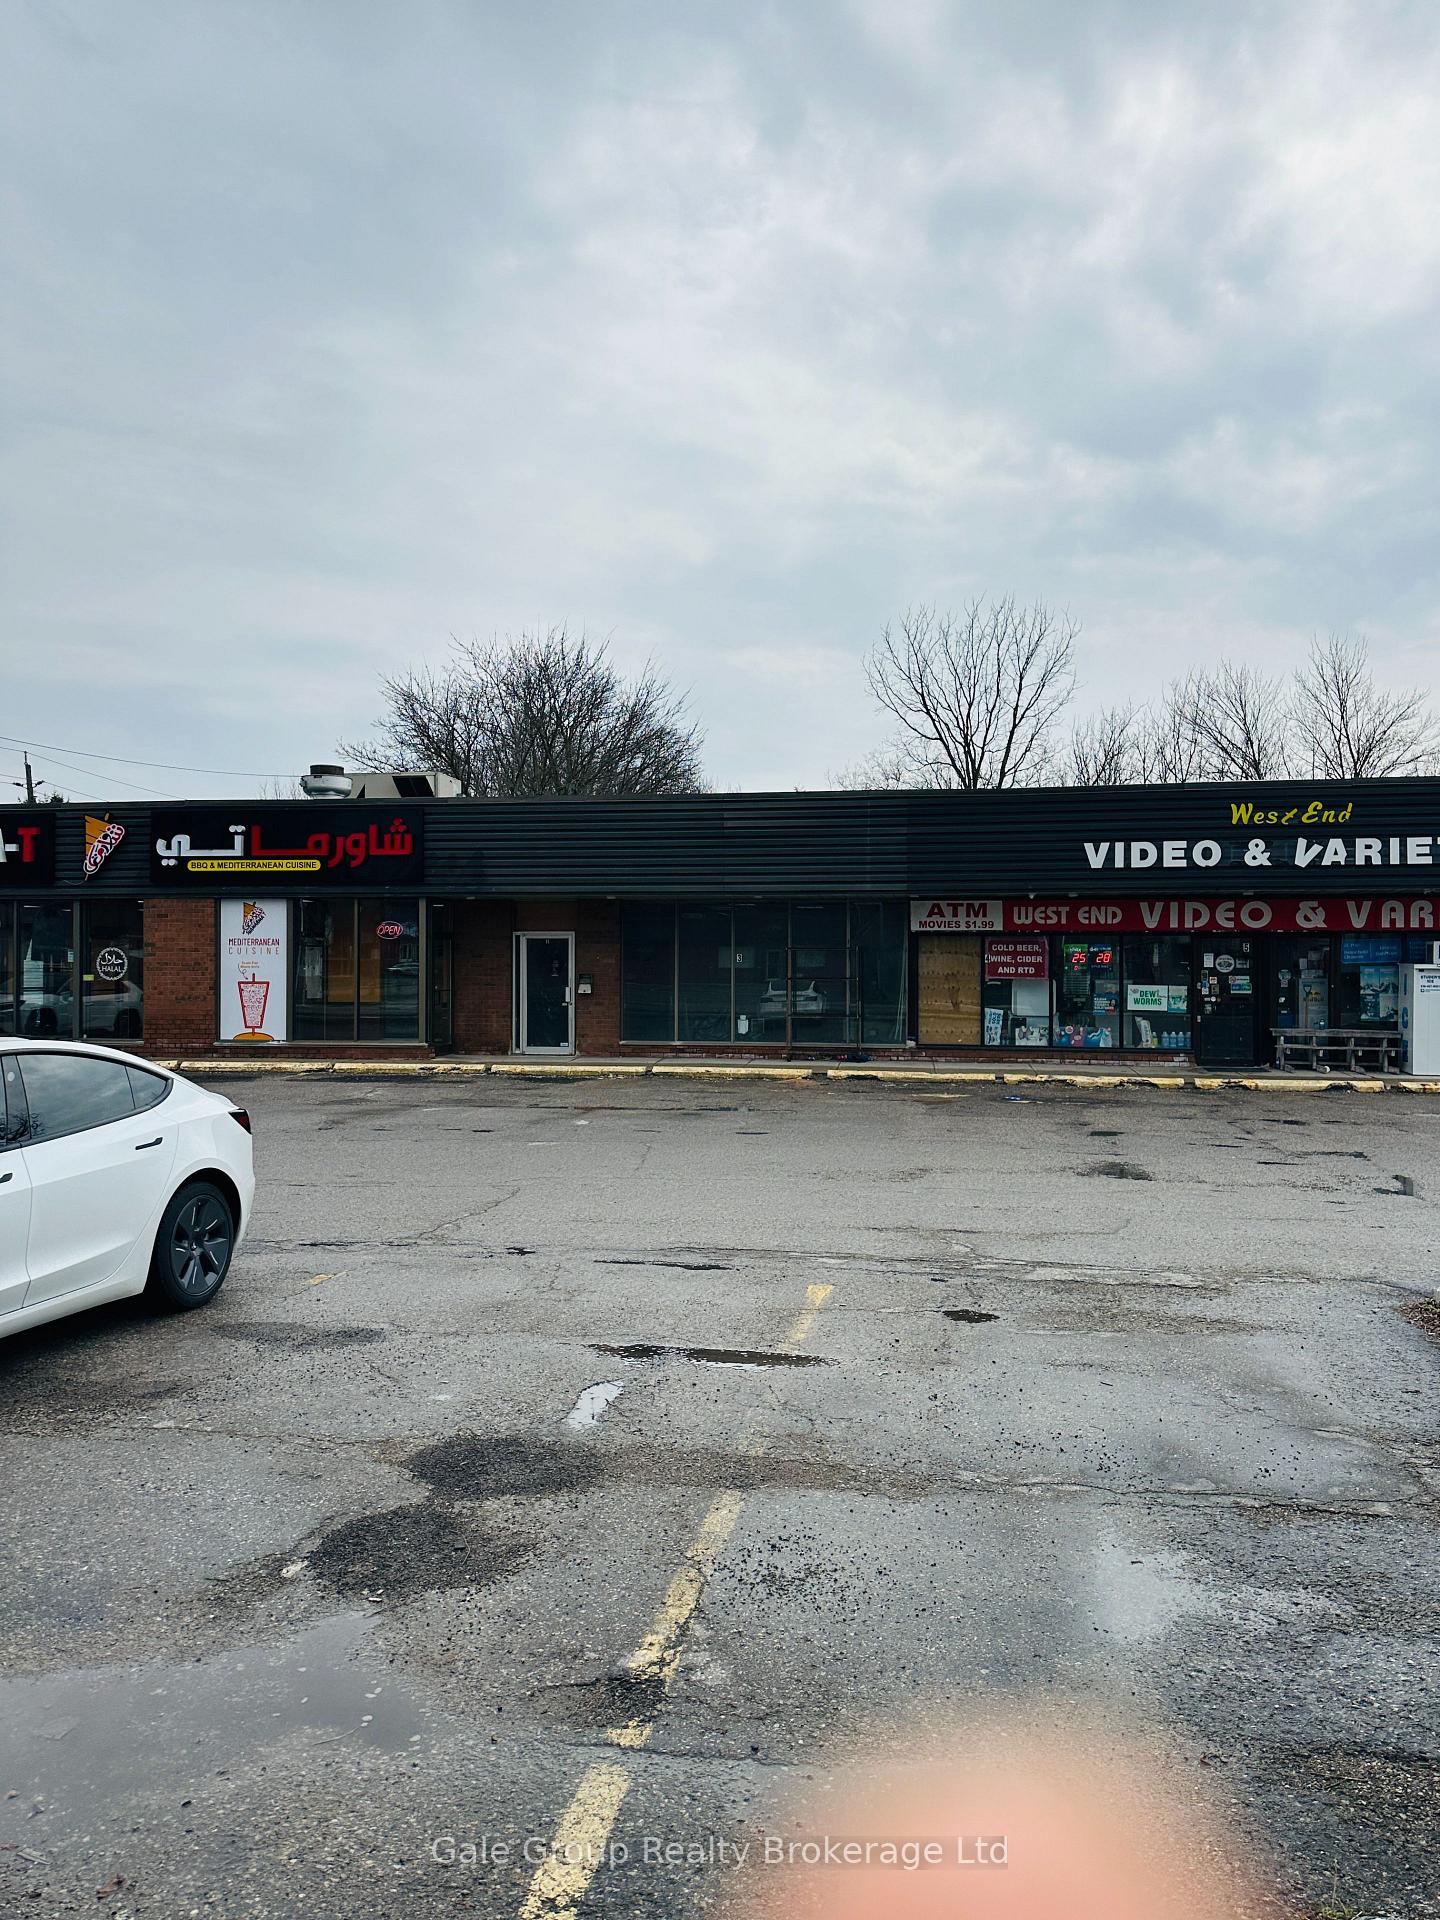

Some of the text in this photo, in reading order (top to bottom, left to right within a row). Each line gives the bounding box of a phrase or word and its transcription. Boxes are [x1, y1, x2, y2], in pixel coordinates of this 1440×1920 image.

[1230, 801, 1353, 825] West End
[0, 826, 41, 863] -T
[1083, 836, 1440, 869] VIDEO & VARIE
[190, 861, 317, 870] BBQ & MEDITERRANEAN CUISINE
[927, 903, 988, 918] ATM
[1013, 900, 1440, 929] WEST END VIDEO & VAR
[919, 920, 995, 929] MOVIES $1.99
[378, 925, 401, 936] OPEN
[229, 938, 280, 946] MEDITERRANEAN
[229, 947, 280, 955] CUISINE
[992, 944, 1042, 953] COLD BEER,
[1243, 943, 1250, 952] 5
[736, 953, 743, 963] 3
[990, 954, 1043, 963] WINE, CIDER
[1072, 953, 1086, 963] 25
[997, 966, 1035, 974] AND RTD
